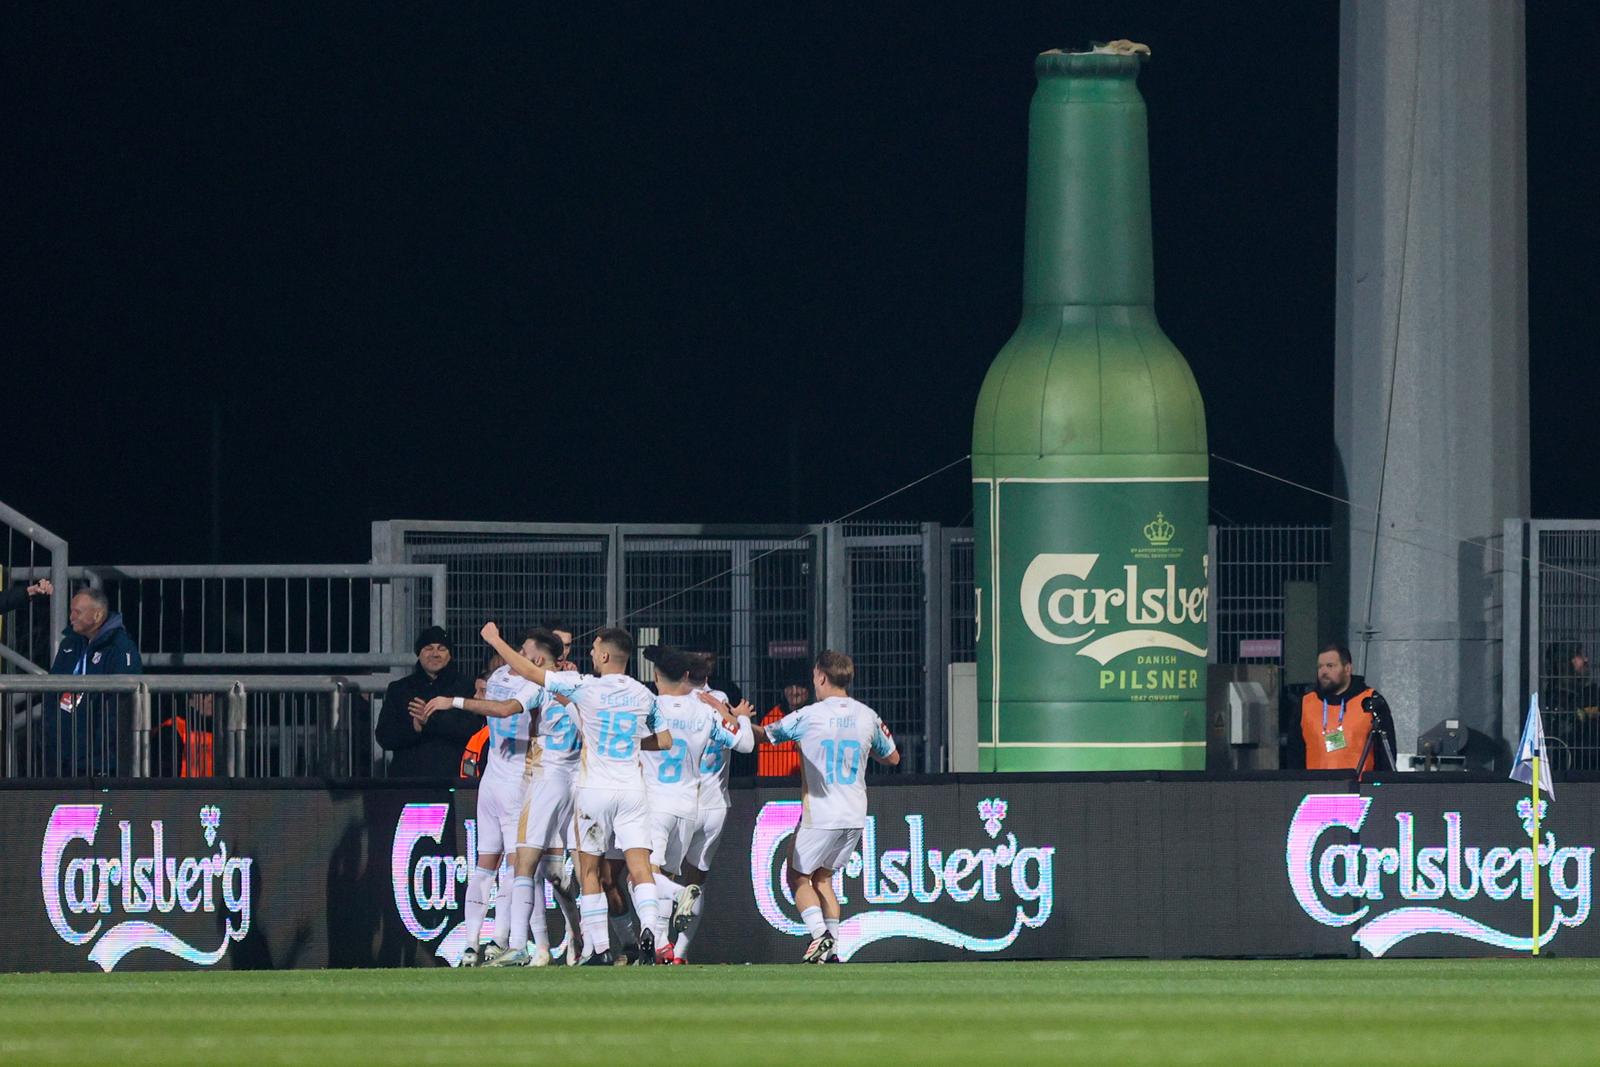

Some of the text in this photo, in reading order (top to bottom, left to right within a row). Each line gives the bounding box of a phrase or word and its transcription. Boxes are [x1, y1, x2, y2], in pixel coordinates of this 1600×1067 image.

[1100, 670, 1198, 689] PILSNER
[1137, 655, 1177, 665] DANISH
[596, 711, 638, 759] 18
[658, 738, 687, 784] 8
[821, 739, 860, 785] 10
[41, 804, 252, 971] Carlsberg
[1286, 794, 1594, 957] Carlsberg
